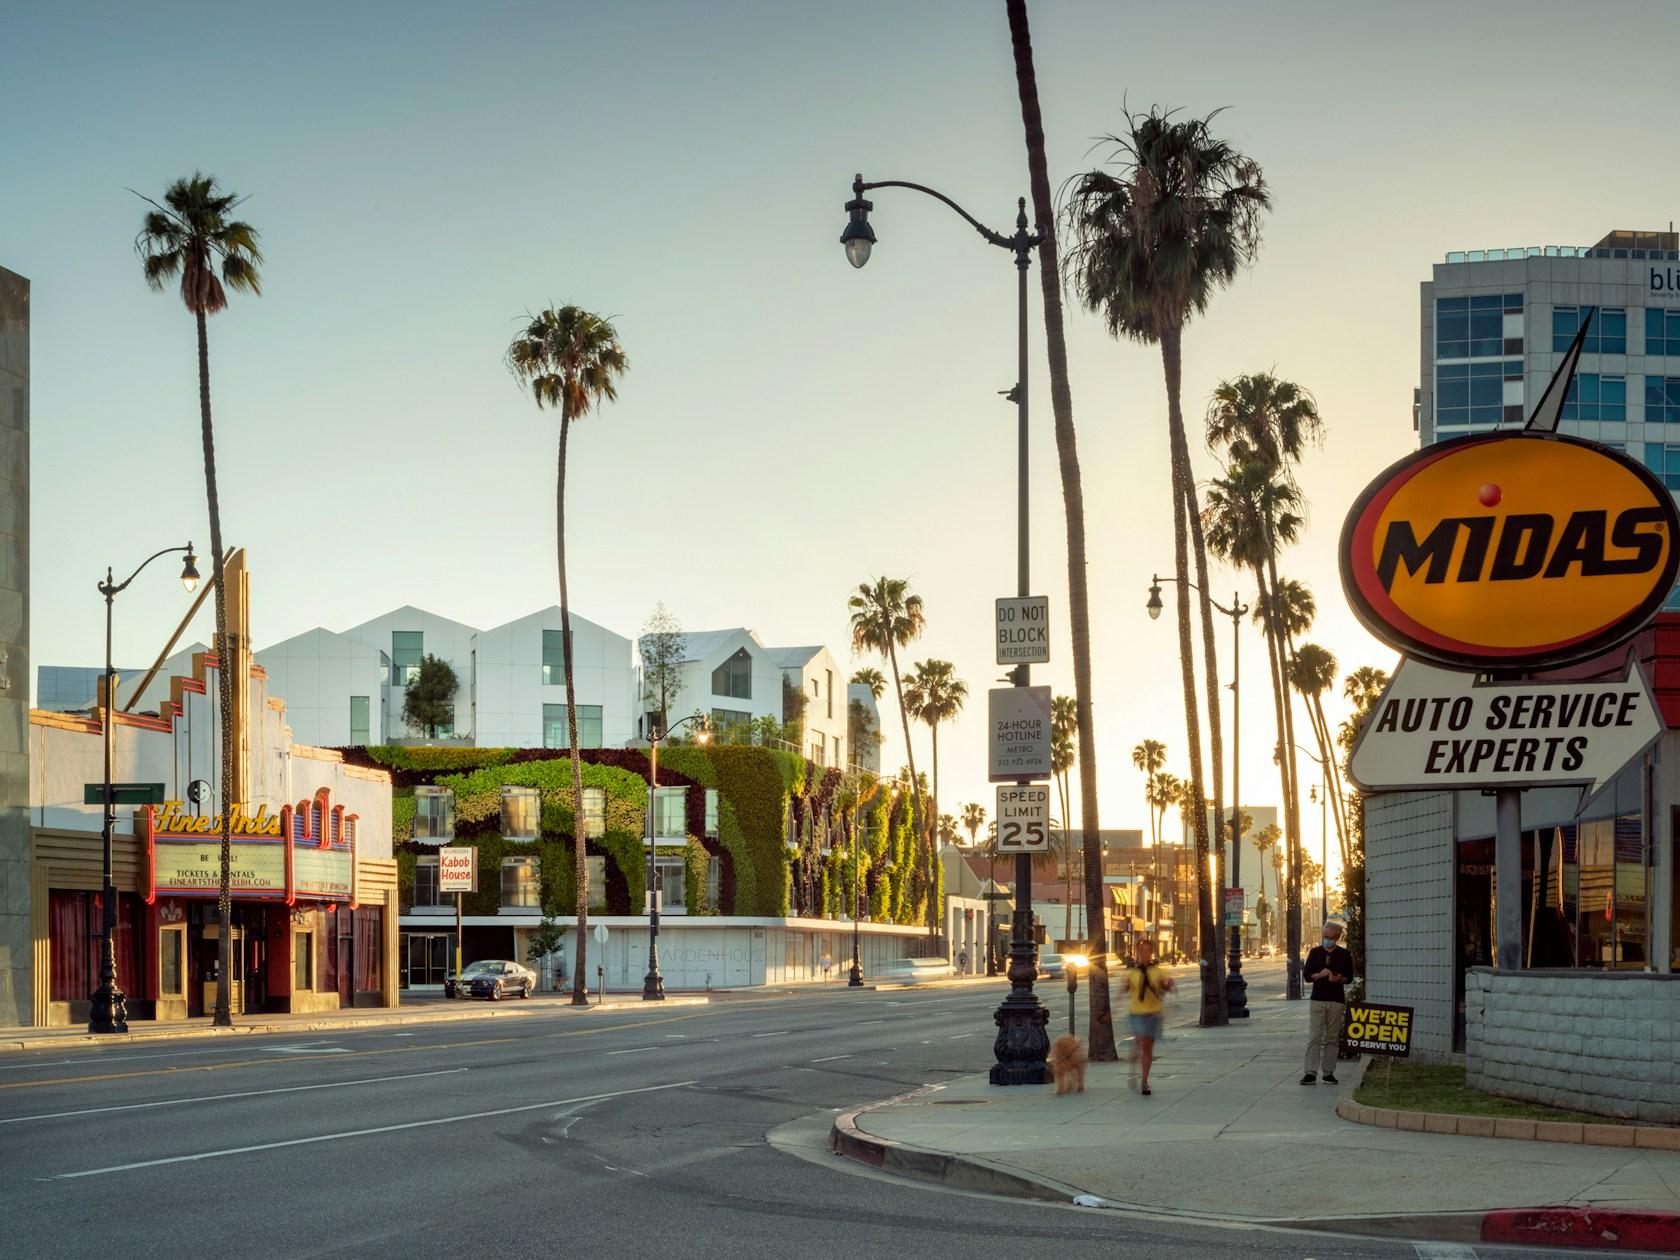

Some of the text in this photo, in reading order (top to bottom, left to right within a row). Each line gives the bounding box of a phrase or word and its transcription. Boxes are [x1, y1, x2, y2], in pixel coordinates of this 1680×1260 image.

[1377, 505, 1666, 595] MIDAS
[998, 606, 1045, 622] DO NOT
[999, 627, 1046, 643] BLOCK
[1000, 646, 1046, 657] INTERSECTION
[1376, 692, 1640, 732] AUTO SERVICE
[997, 719, 1042, 731] 24-HOUR
[997, 731, 1042, 741] HOTLINE
[1007, 744, 1034, 754] METRO
[1424, 736, 1588, 774] EXPERTS
[1000, 791, 1046, 802] SPEED
[153, 800, 209, 833] Fine
[1004, 807, 1042, 817] LIMIT
[1002, 821, 1044, 846] 25
[200, 854, 209, 862] BE
[441, 856, 470, 867] Kabob
[177, 870, 209, 878] TICKETS
[441, 869, 472, 880] House
[1350, 1007, 1410, 1027] WE'RE
[1347, 1022, 1409, 1044] OPEN
[1346, 1039, 1407, 1052] TO SERVE YOU
